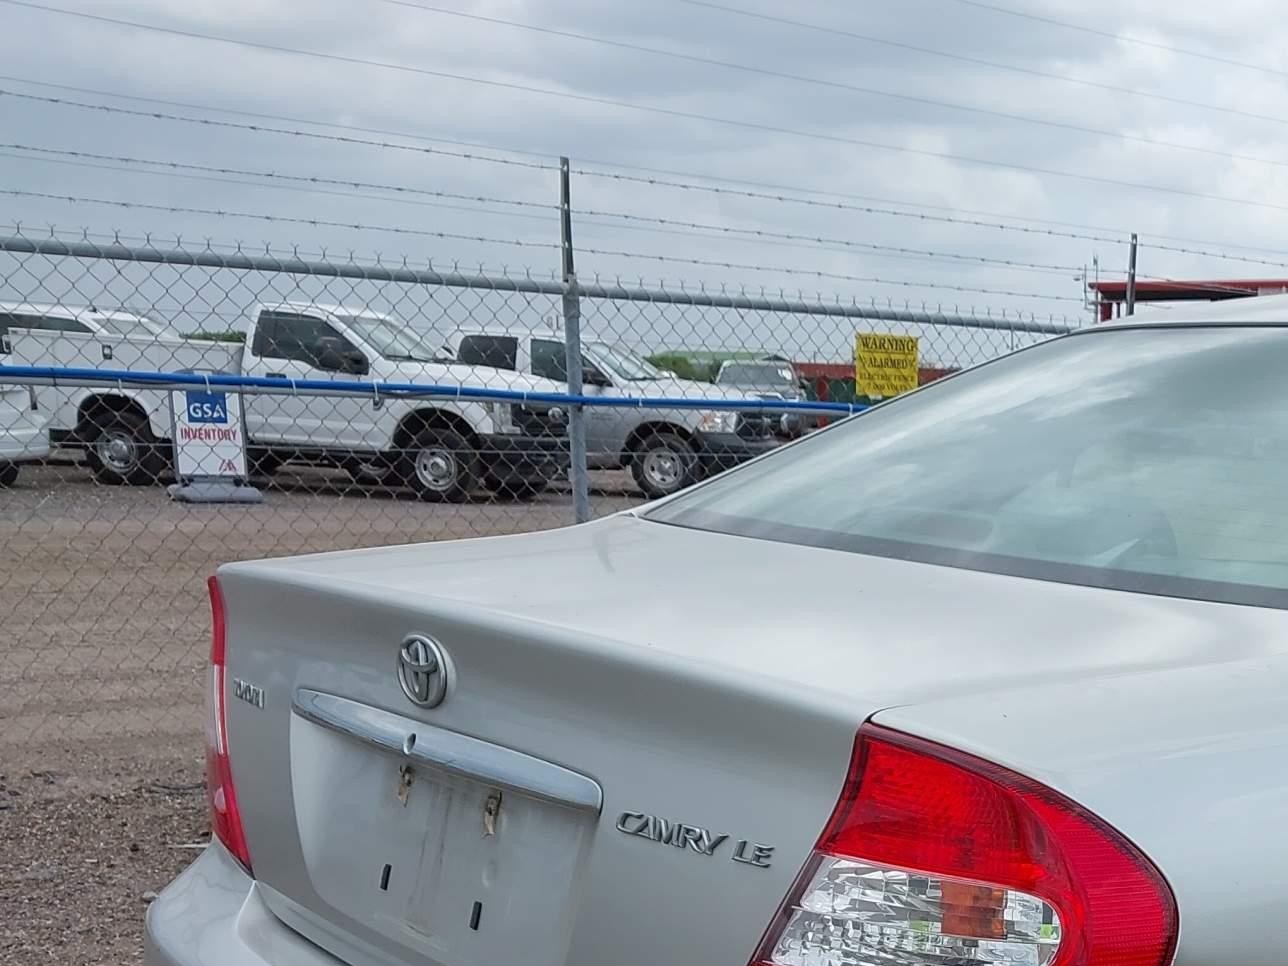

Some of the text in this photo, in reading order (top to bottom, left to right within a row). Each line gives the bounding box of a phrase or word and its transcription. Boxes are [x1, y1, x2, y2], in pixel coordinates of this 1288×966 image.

[861, 336, 914, 351] WARNING
[867, 357, 908, 369] ALARMED
[189, 402, 225, 418] GSA
[181, 428, 237, 441] INVENTORY
[615, 809, 775, 869] CAMRY LE
